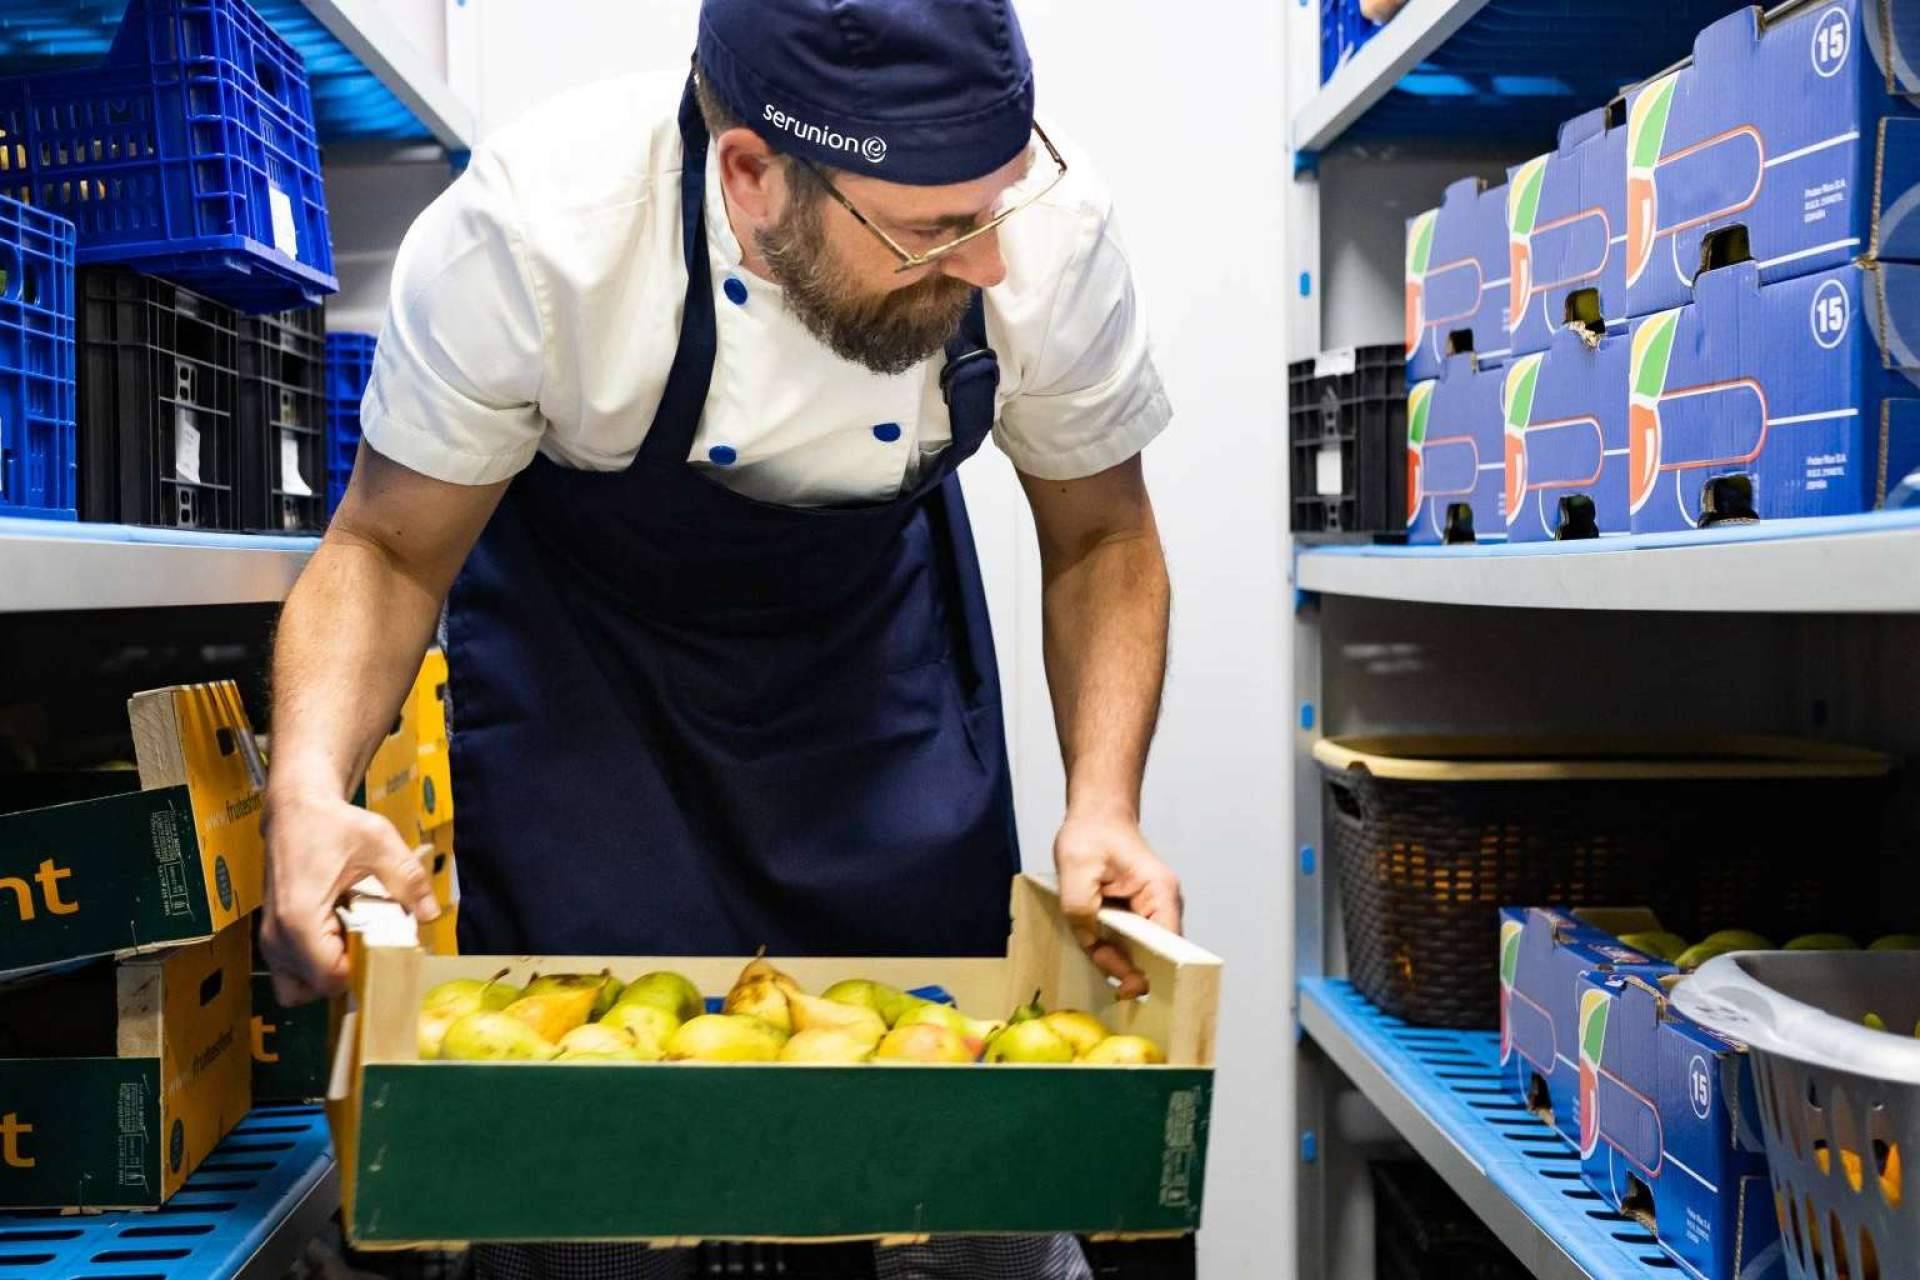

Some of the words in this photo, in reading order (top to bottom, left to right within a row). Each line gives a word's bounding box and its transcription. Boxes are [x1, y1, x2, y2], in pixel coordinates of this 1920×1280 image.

[1818, 22, 1844, 63] 15
[762, 103, 859, 153] serunion
[1817, 295, 1843, 333] 15
[1692, 1071, 1708, 1106] 15
